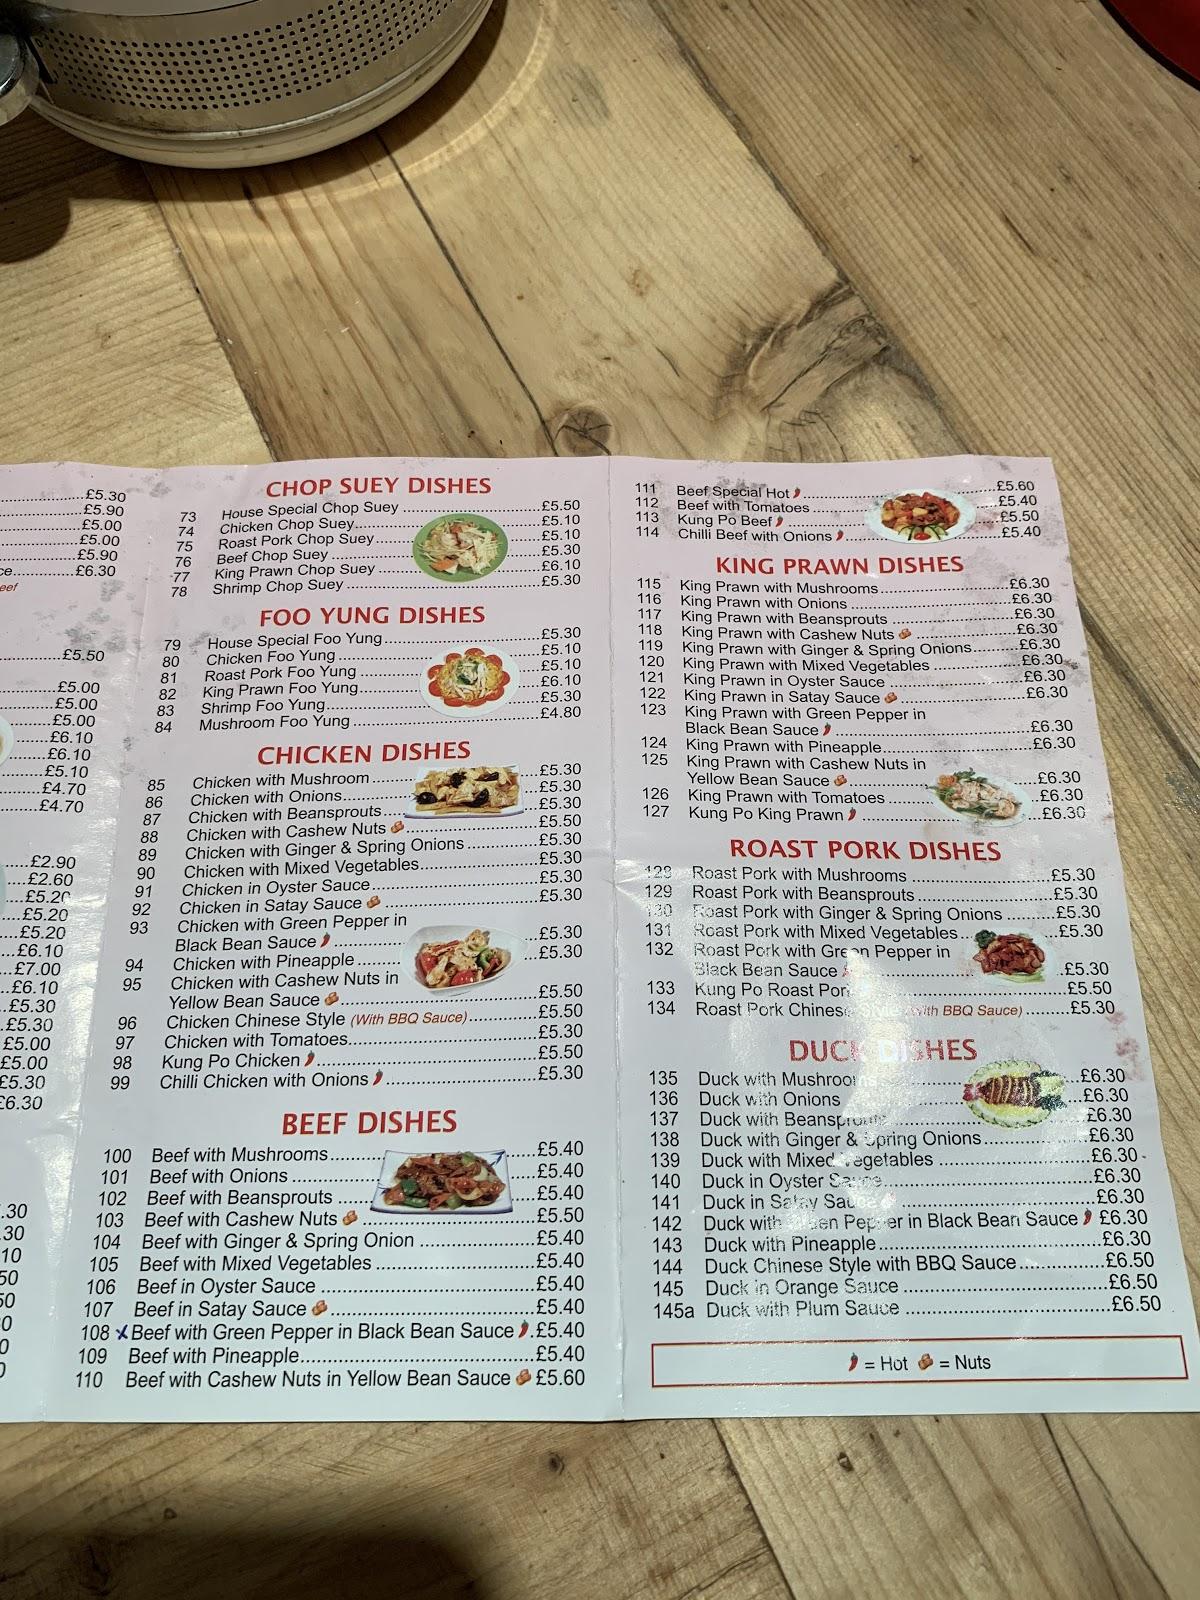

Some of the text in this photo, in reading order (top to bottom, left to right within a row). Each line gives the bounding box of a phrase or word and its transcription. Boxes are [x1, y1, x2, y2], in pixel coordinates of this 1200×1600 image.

[85, 488, 126, 503] £5.30
[266, 477, 491, 498] CHOP SUEY DISHES
[635, 480, 1035, 499] 111 Beef Special Hot £5.60
[83, 503, 124, 517] £5.90
[180, 499, 580, 523] 73 House Special Chop Suey £5.50
[176, 528, 581, 552] 75 Roast Pork Chop Suey £5.10
[636, 525, 1041, 542] 114 Chilli Beef with Onions £5.40
[75, 564, 116, 577] £6.30
[716, 556, 964, 575] KING PRAWN DISHES
[171, 573, 581, 598] 78 Shrimp Chop Suey £5.30
[637, 577, 1050, 595] 115 King Prawn with Mushrooms £6.30
[260, 606, 485, 627] FOO YUNG DISHES
[164, 626, 581, 651] 79 House Special Foo Yung £5.30
[62, 648, 105, 662] £5.50
[57, 680, 100, 694] £5.00
[639, 669, 1066, 690] 121 King Prawn in Oyster Sauce £6.30
[257, 741, 471, 765] CHICKEN DISHES
[147, 763, 582, 792] 85 Chicken with Mushroom £5.30
[39, 799, 84, 814] £4.70
[643, 804, 1086, 824] 127 Kung Po King Prawn £6.30
[138, 832, 582, 862] 89 Chicken with Ginger & Spring Onions £5.30
[730, 839, 1001, 862] ROAST PORK DISHES
[30, 854, 76, 870] £2.90
[645, 884, 1098, 904] 129 Roast Pork with Beansprouts £5.30
[125, 944, 583, 972] 94 Chicken with Pineapple £5.30
[14, 961, 61, 977] £7.00
[2, 1036, 51, 1051] £5.00
[110, 1064, 583, 1090] 99 Chilli Chicken with Onions £5.30
[282, 1109, 457, 1135] BEEF DISHES
[104, 1140, 584, 1164] 100 Beef with Mushrooms £5.40
[653, 1230, 1151, 1255] 143 Duck with Pineapple £6.30
[90, 1252, 584, 1275] 105 Beef with Mixed Vegetables £5.40
[653, 1251, 1154, 1277] 144 Duck Chinese Style with BBQ Sauce £6.50
[880, 1355, 909, 1371] Hot
[955, 1354, 991, 1370] Nuts
[76, 1368, 585, 1388] 110 Beef with Cashew Nuts in Yellow Bean Sauce £5.60
